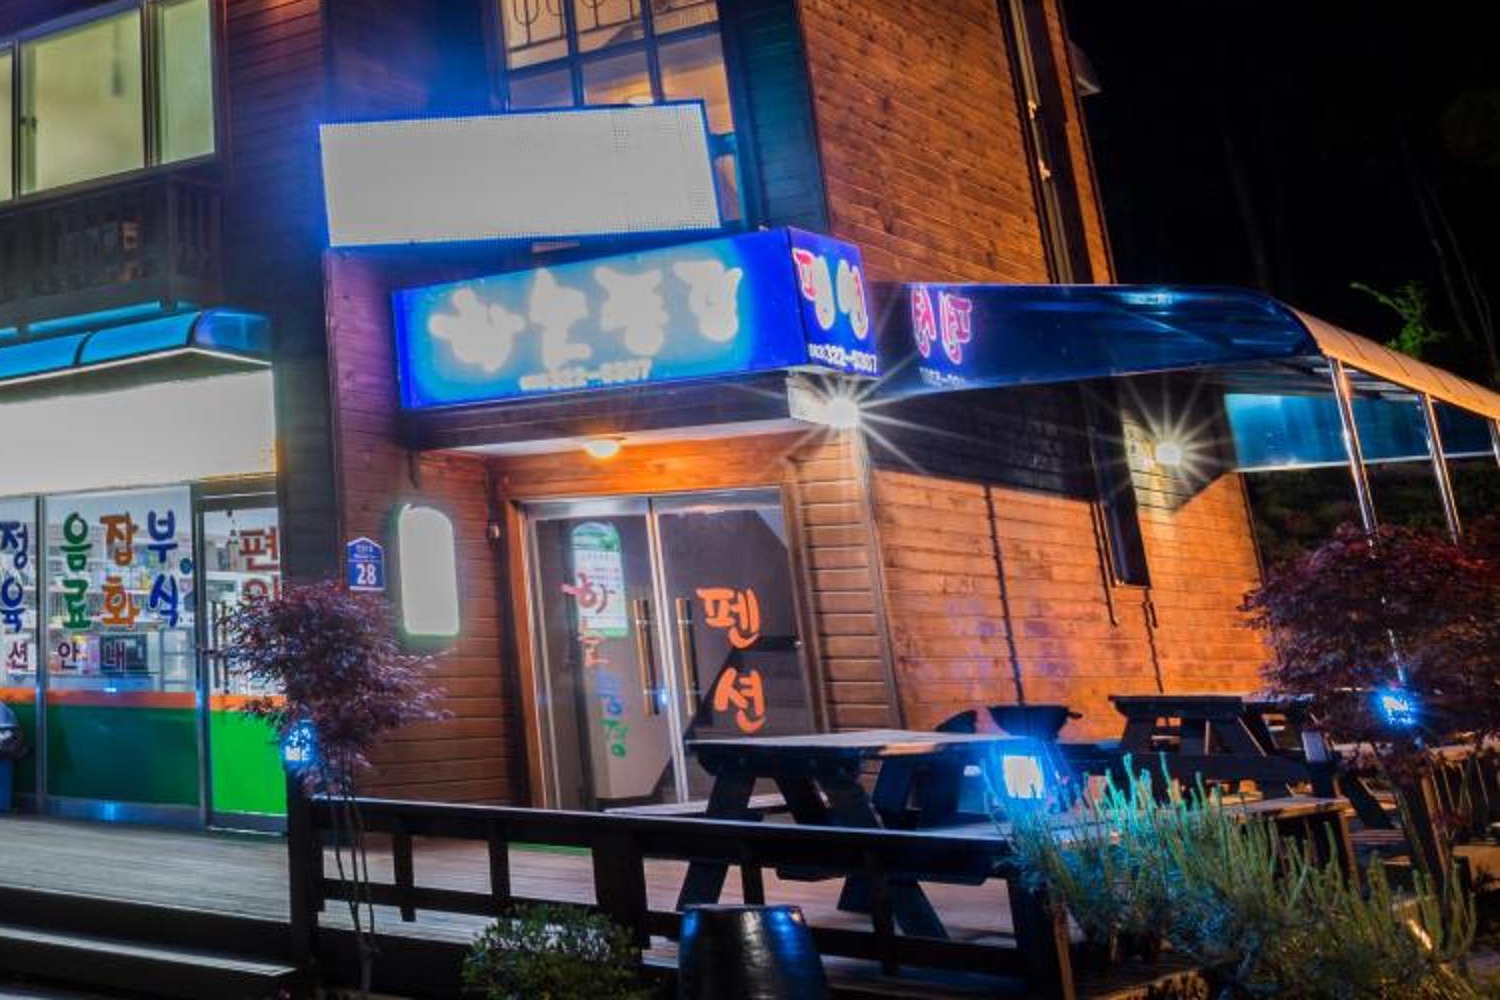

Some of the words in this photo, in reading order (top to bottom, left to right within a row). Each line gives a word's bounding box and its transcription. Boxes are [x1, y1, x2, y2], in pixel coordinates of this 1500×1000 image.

[60, 512, 92, 629] 음료
[99, 510, 140, 629] 잡화
[148, 509, 179, 629] 부식
[356, 563, 377, 585] 28
[695, 587, 766, 735] 펜션
